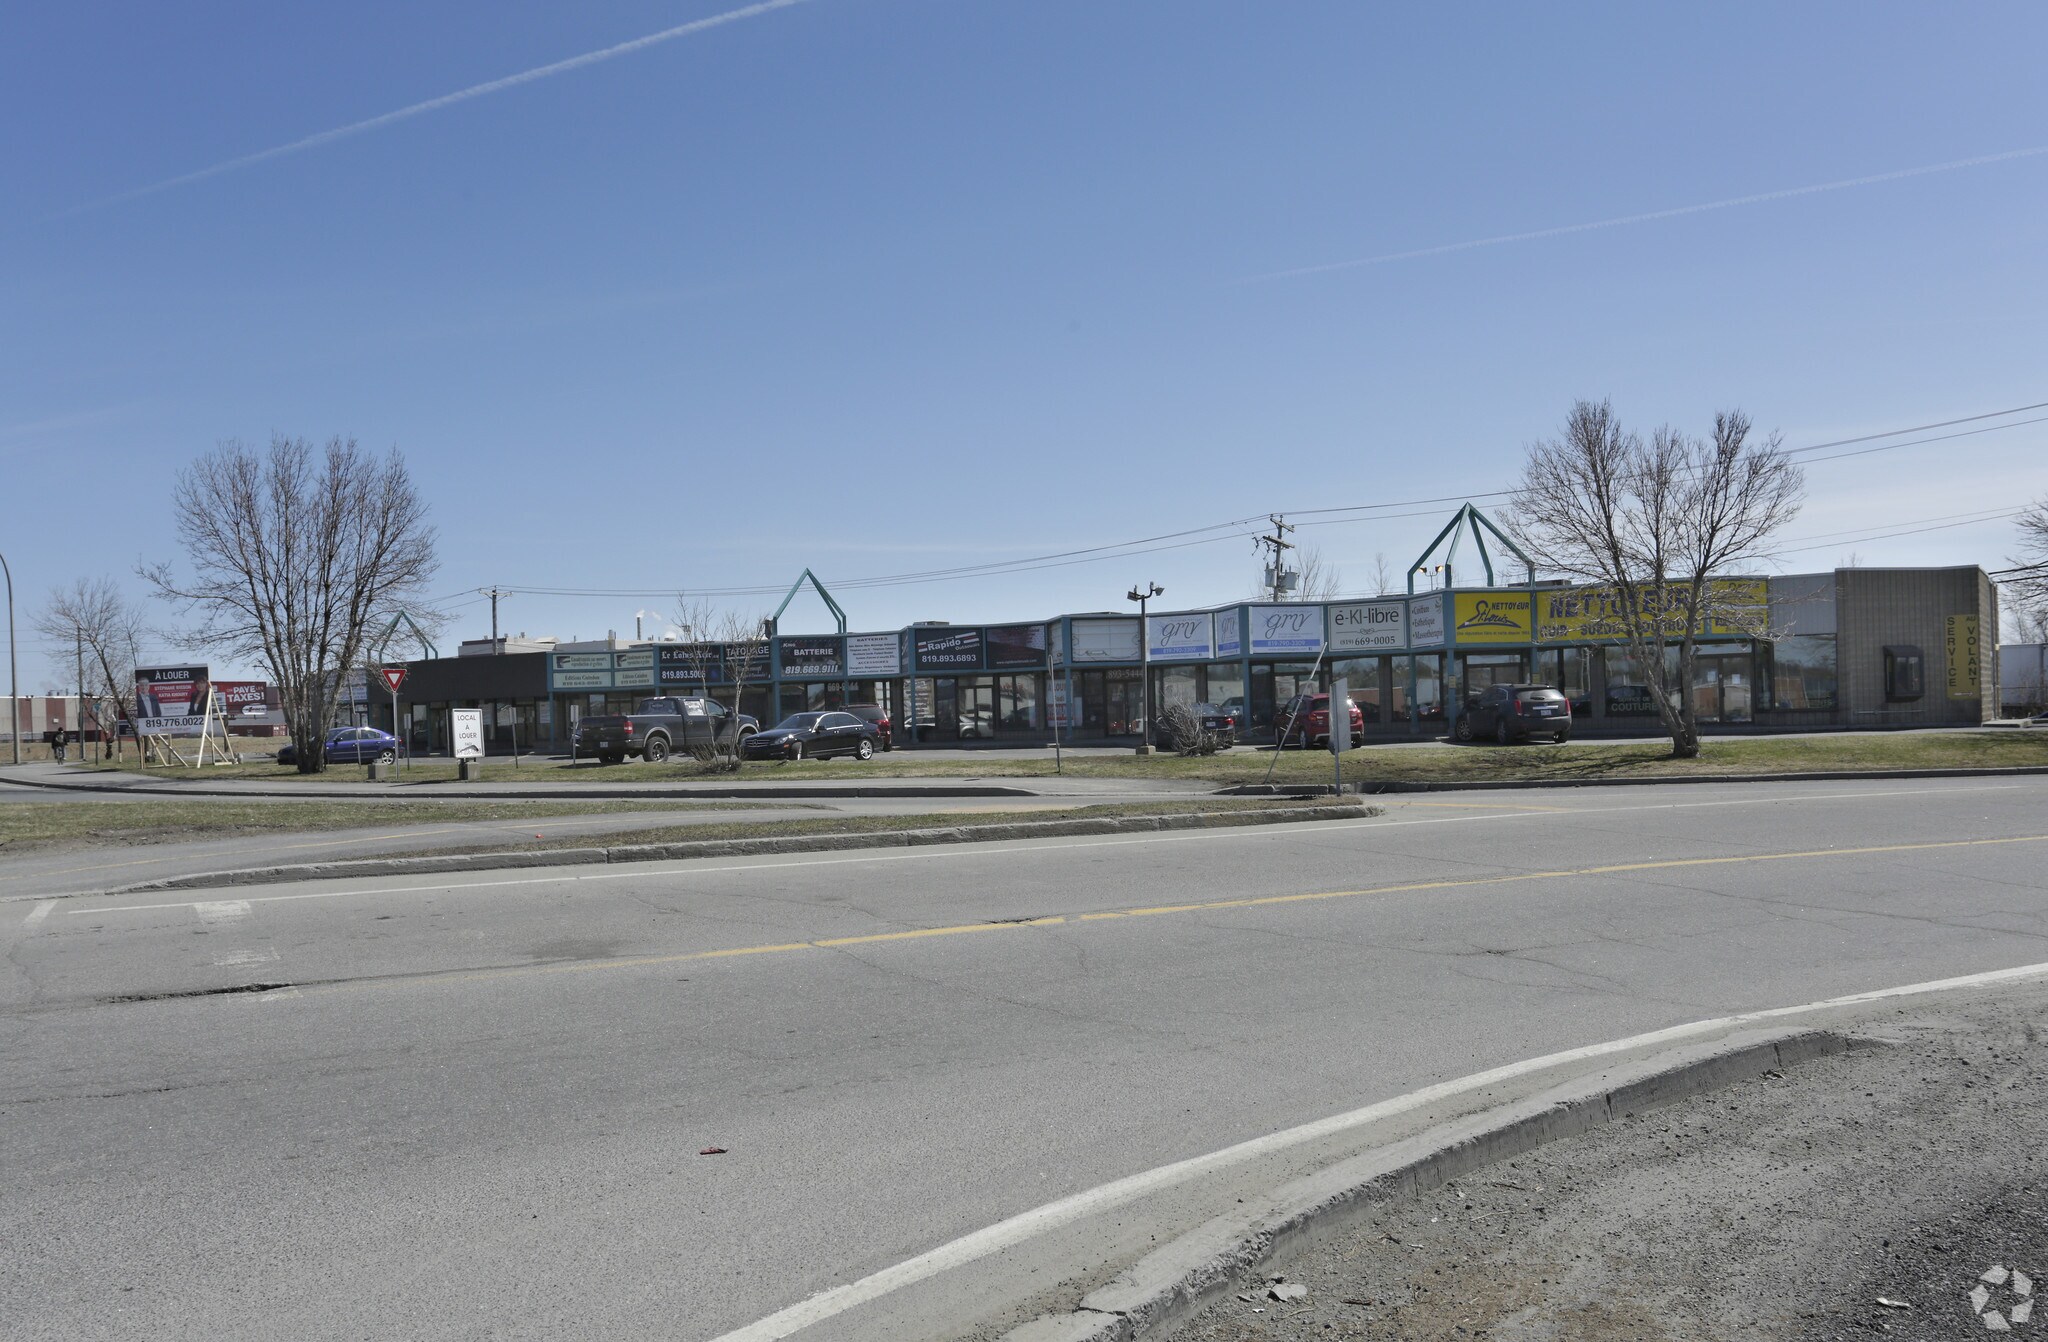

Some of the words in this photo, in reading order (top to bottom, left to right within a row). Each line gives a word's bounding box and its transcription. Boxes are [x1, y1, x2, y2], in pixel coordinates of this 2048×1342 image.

[1491, 602, 1530, 610] NETTOYEUR
[1549, 587, 1691, 618] NETTOEUR
[927, 639, 961, 651] Rapido
[662, 651, 670, 659] Le
[793, 648, 834, 656] BATTERIE
[1946, 616, 1957, 687] SERVICE
[1967, 626, 1977, 686] VOLANT
[921, 654, 977, 663] 819.893.6893
[785, 665, 838, 674] 819.669.9111
[155, 670, 161, 680] À
[163, 671, 189, 680] LOUER
[233, 686, 256, 694] PAYE
[227, 692, 265, 703] TAXES!
[1611, 703, 1658, 712] COUTURE
[145, 716, 204, 728] 819.776.0022
